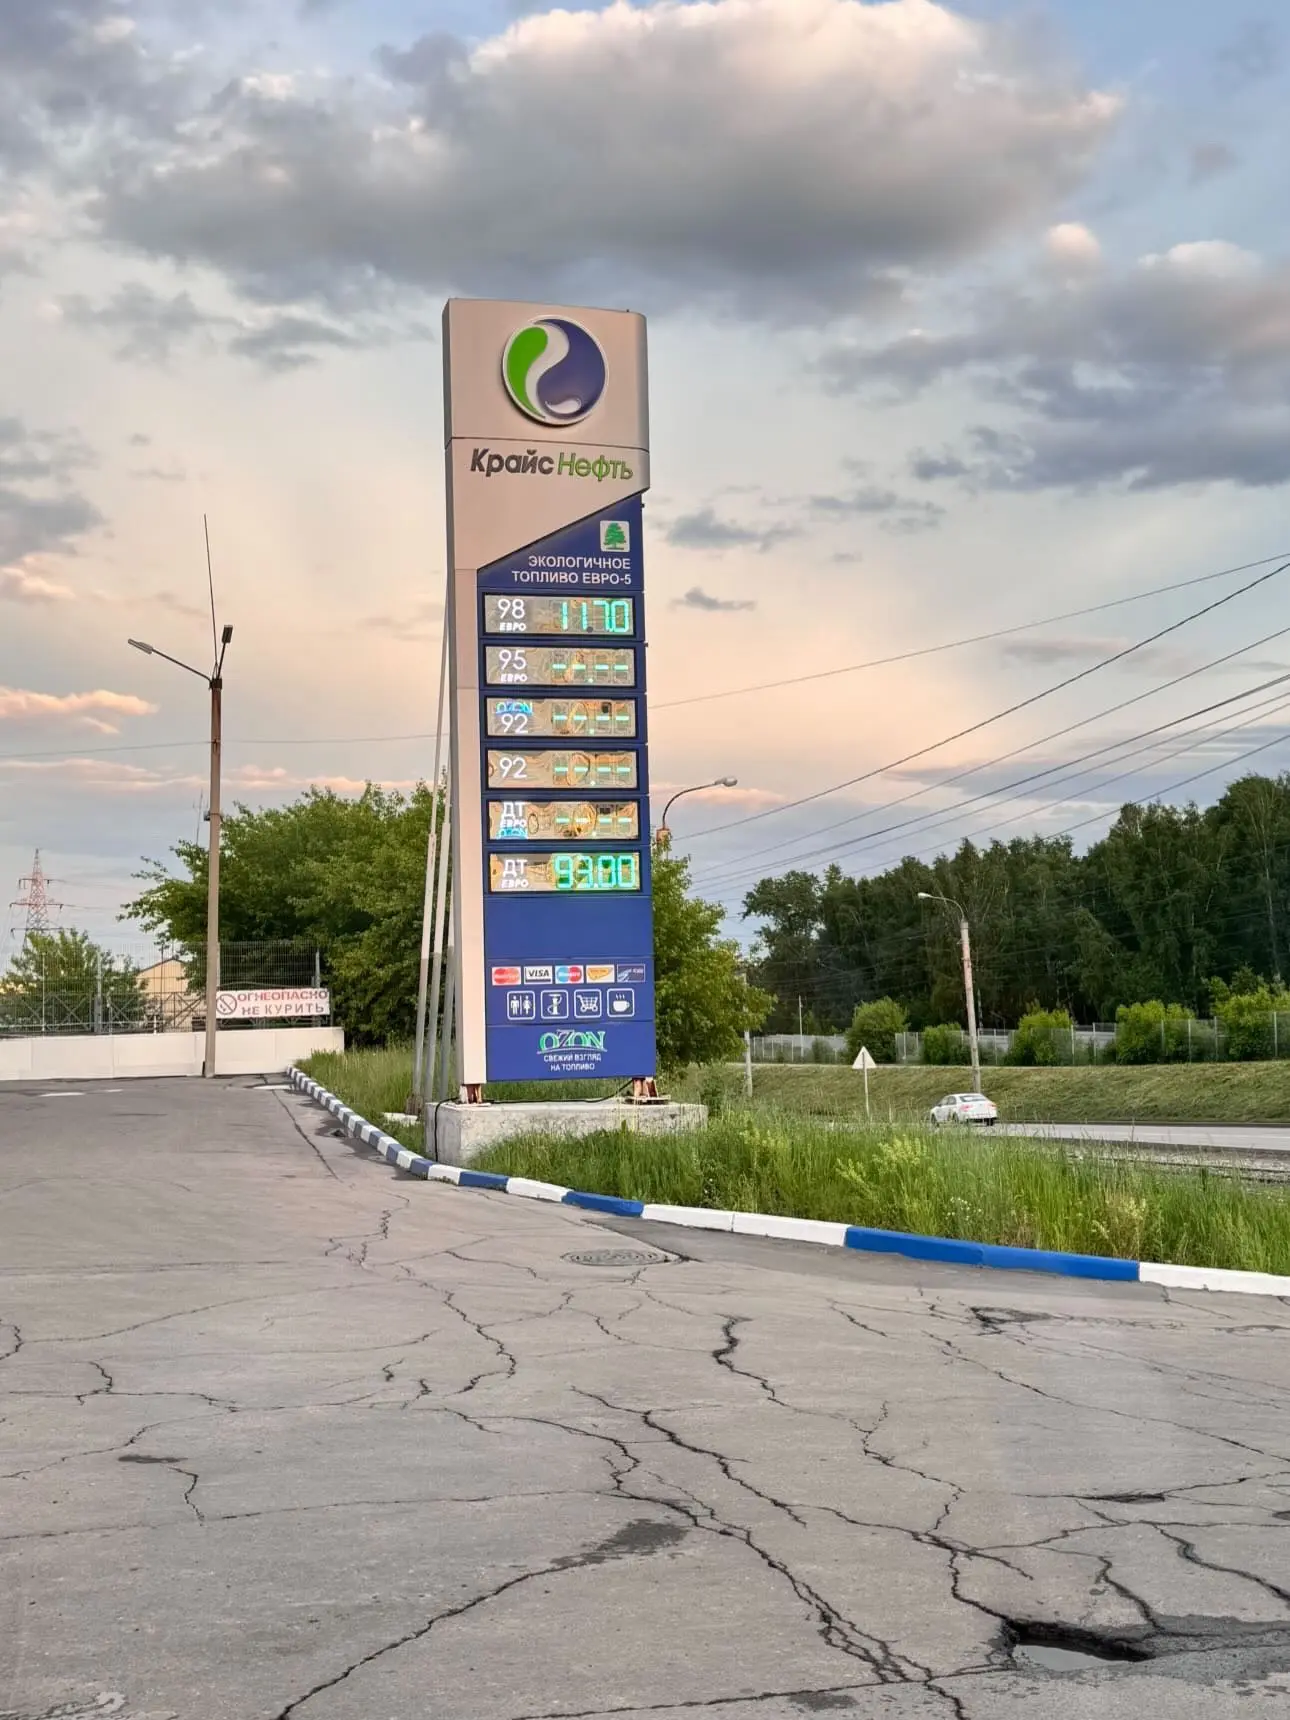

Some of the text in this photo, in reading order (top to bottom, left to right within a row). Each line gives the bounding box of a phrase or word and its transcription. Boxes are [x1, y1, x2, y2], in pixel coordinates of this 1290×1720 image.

[528, 555, 631, 570] ЭКОЛОГИЧНОЕ
[511, 570, 632, 585] ТОПЛИВО ЕВРО-5
[497, 598, 526, 620] 98
[499, 622, 527, 632] ЕВРО
[498, 649, 527, 671] 95
[500, 713, 529, 734] 92
[499, 756, 528, 779] 92
[501, 801, 527, 819] ДТ
[501, 858, 528, 878] ДТ
[500, 878, 529, 889] ЕВРО
[528, 968, 550, 978] VISA
[237, 989, 328, 1002] ОГНЕОПАСНО
[241, 1002, 324, 1016] НЕ КУРИТЬ
[538, 1028, 606, 1052] OZON
[550, 1063, 561, 1072] НА
